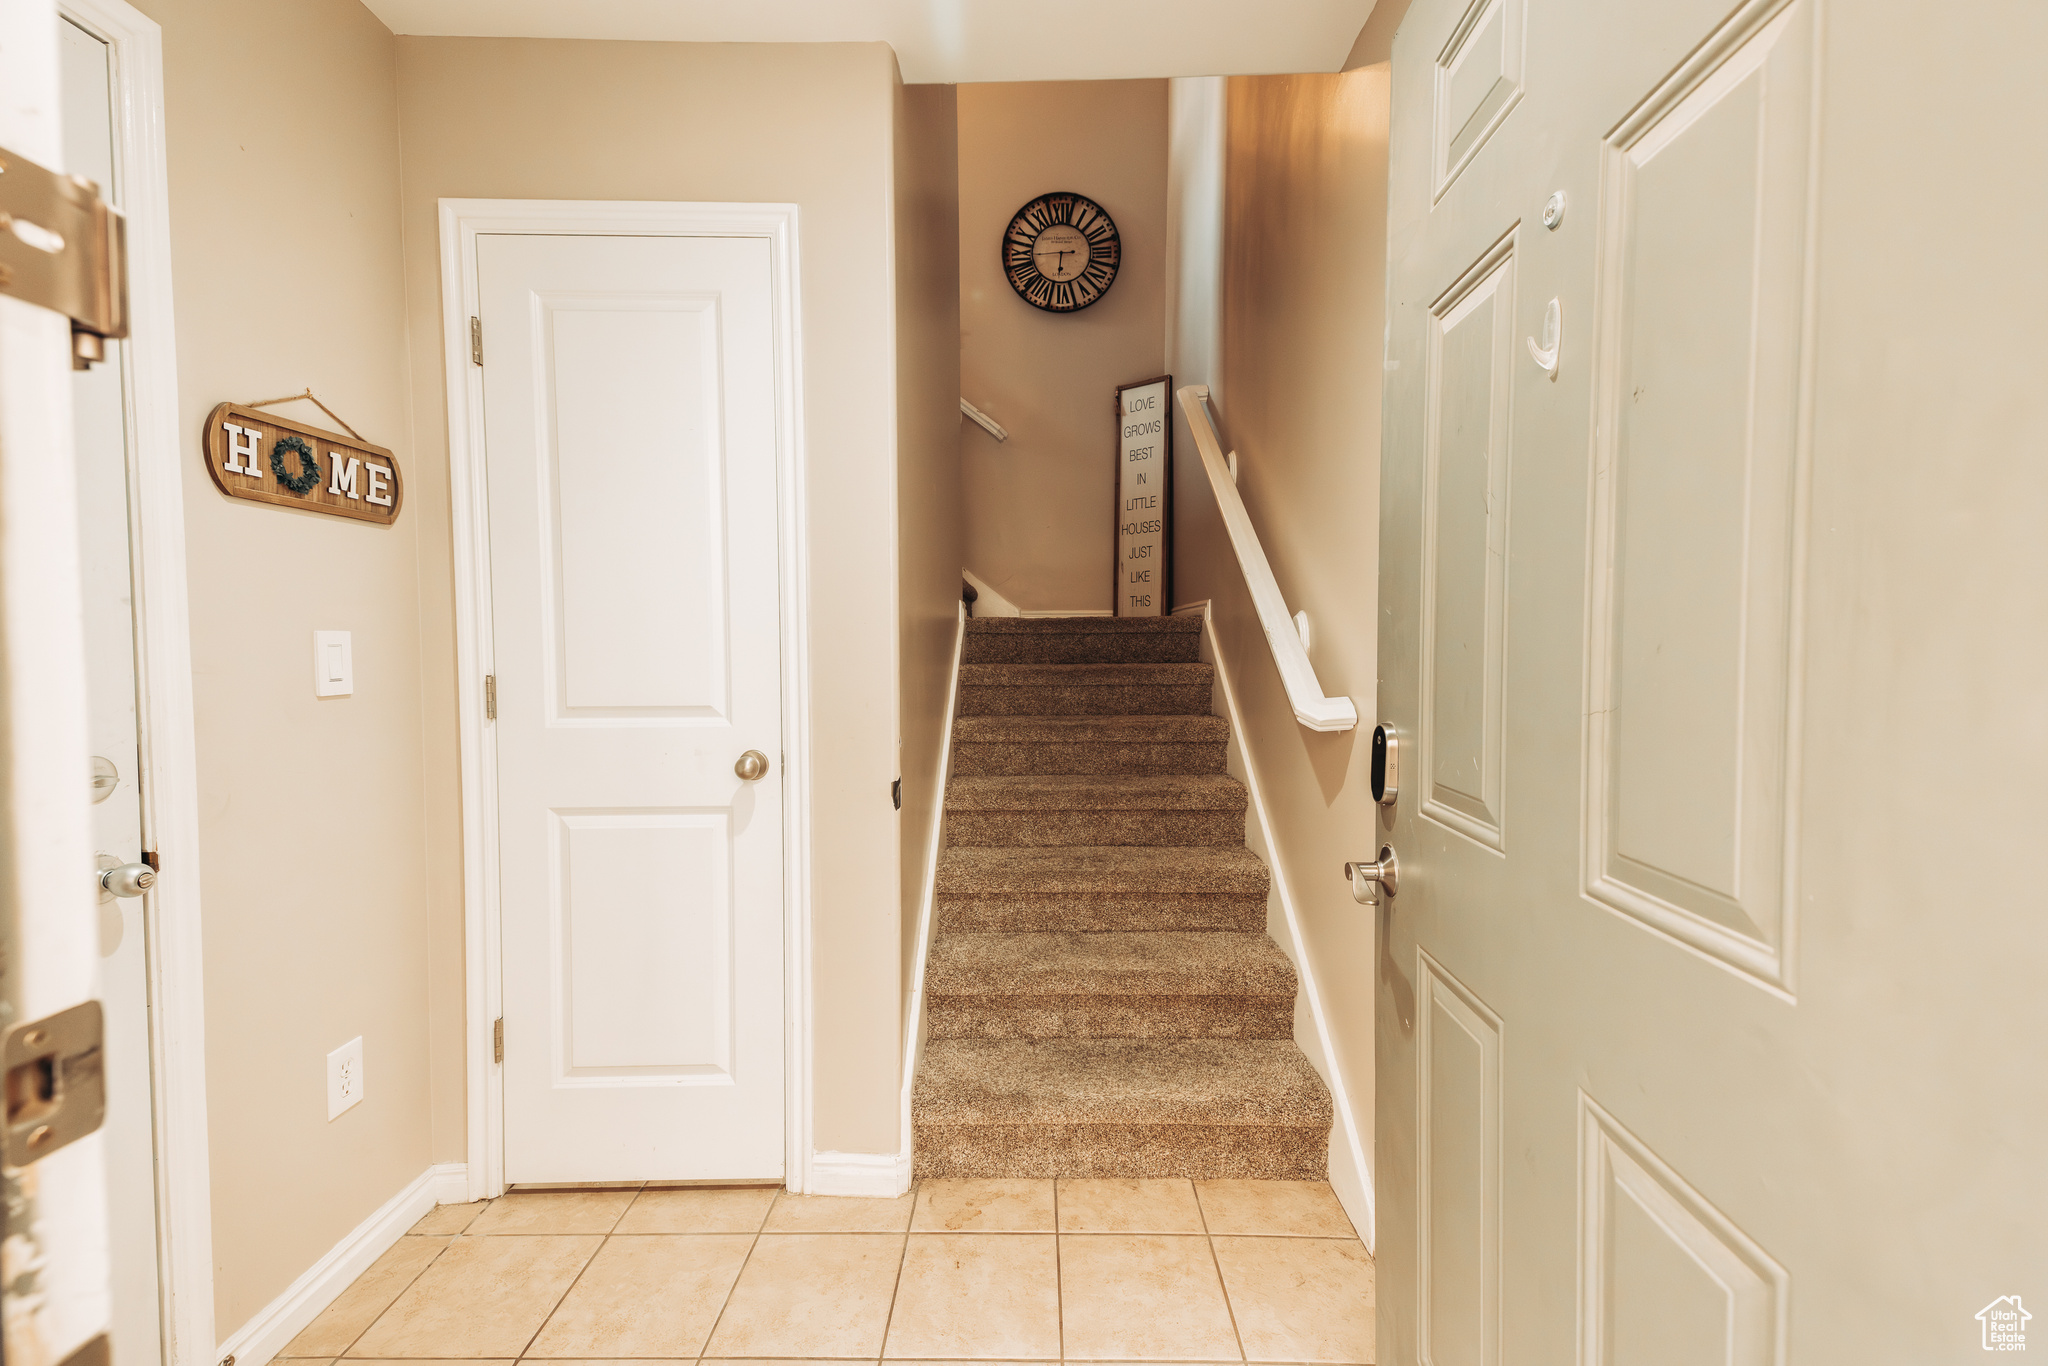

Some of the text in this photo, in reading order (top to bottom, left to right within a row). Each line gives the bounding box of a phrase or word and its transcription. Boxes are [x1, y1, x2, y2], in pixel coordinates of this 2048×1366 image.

[1031, 208, 1050, 230] XI
[1053, 203, 1070, 224] XII
[1076, 208, 1087, 227] I
[1016, 227, 1036, 242] X
[1087, 225, 1107, 241] II
[1012, 248, 1030, 261] IX
[1030, 278, 1051, 301] VII
[1056, 284, 1070, 304] VI
[1077, 281, 1091, 298] V
[1129, 396, 1155, 412] LOVE
[1124, 420, 1161, 438] GROWS
[1129, 446, 1154, 462] BEST
[1136, 473, 1146, 485] IN
[1126, 495, 1157, 511] LITTLE
[1121, 520, 1161, 535] HOUSES
[1129, 546, 1153, 559] JUST
[1130, 570, 1151, 583] LIKE
[1130, 595, 1151, 607] THIS
